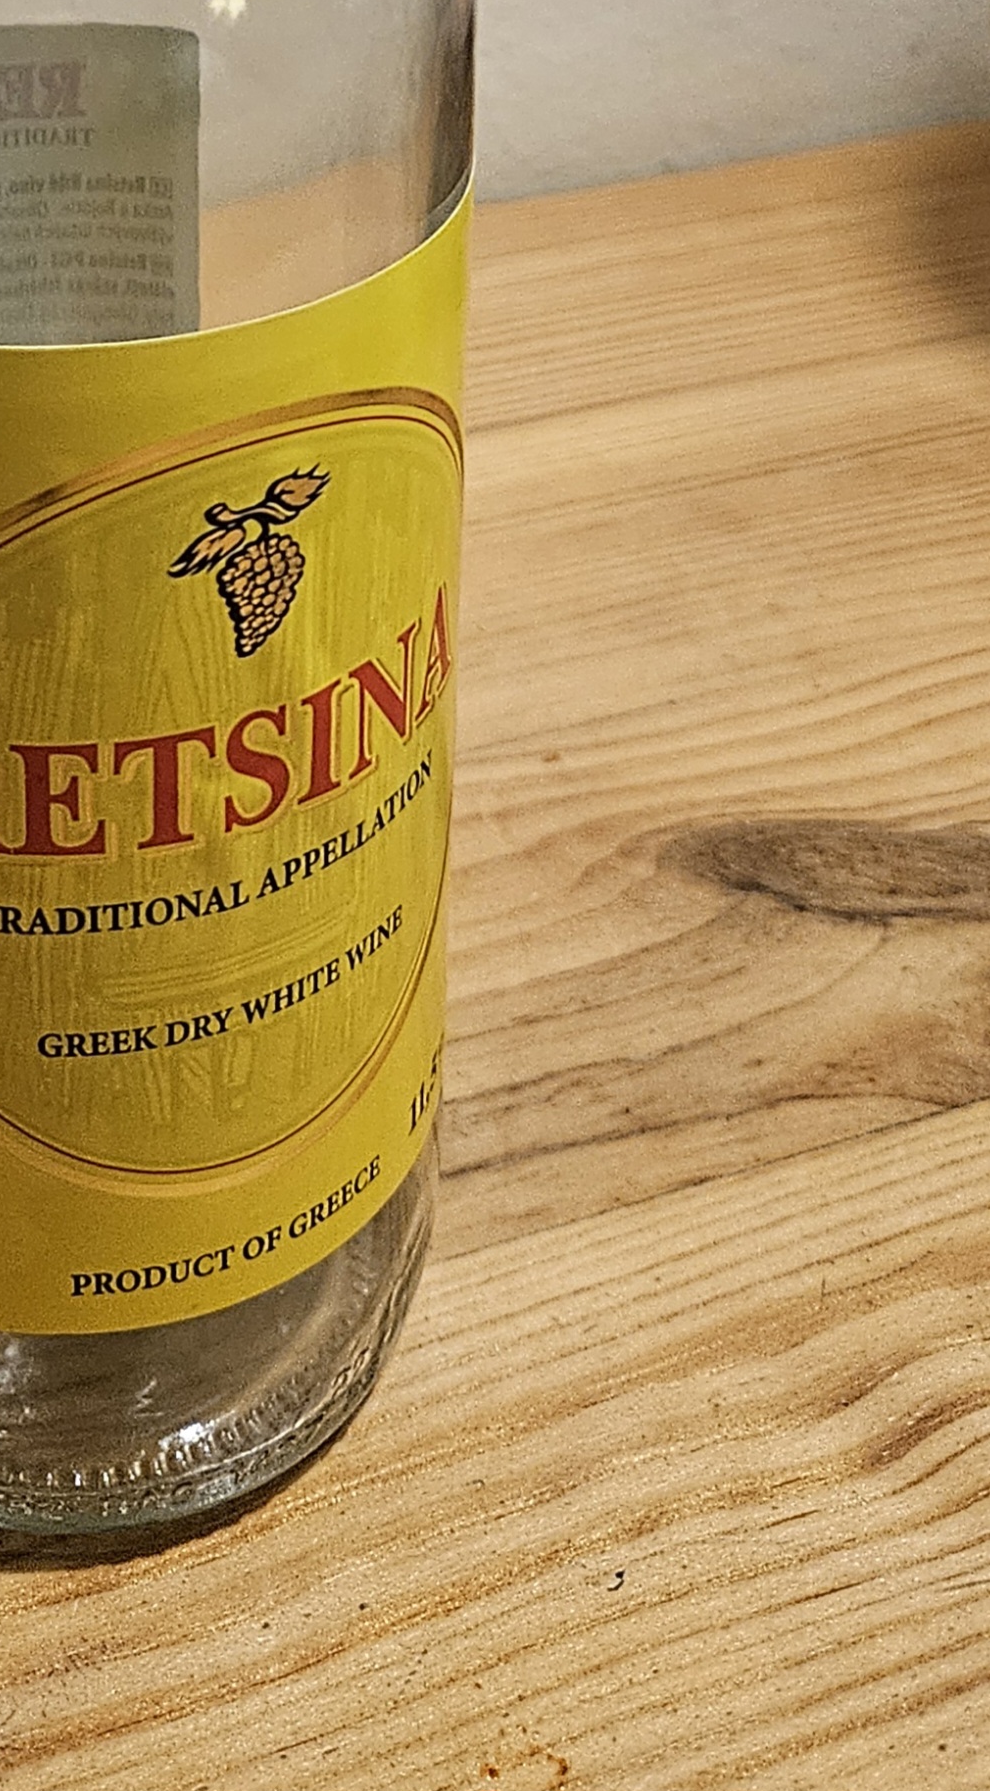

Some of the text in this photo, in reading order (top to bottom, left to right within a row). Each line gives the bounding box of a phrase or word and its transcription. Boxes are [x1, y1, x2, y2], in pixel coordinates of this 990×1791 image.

[257, 749, 433, 899] APPELLATION
[37, 904, 404, 1058] GREEK DRY WHITE WINE
[70, 1154, 381, 1296] PRODUCT OF GREECE
